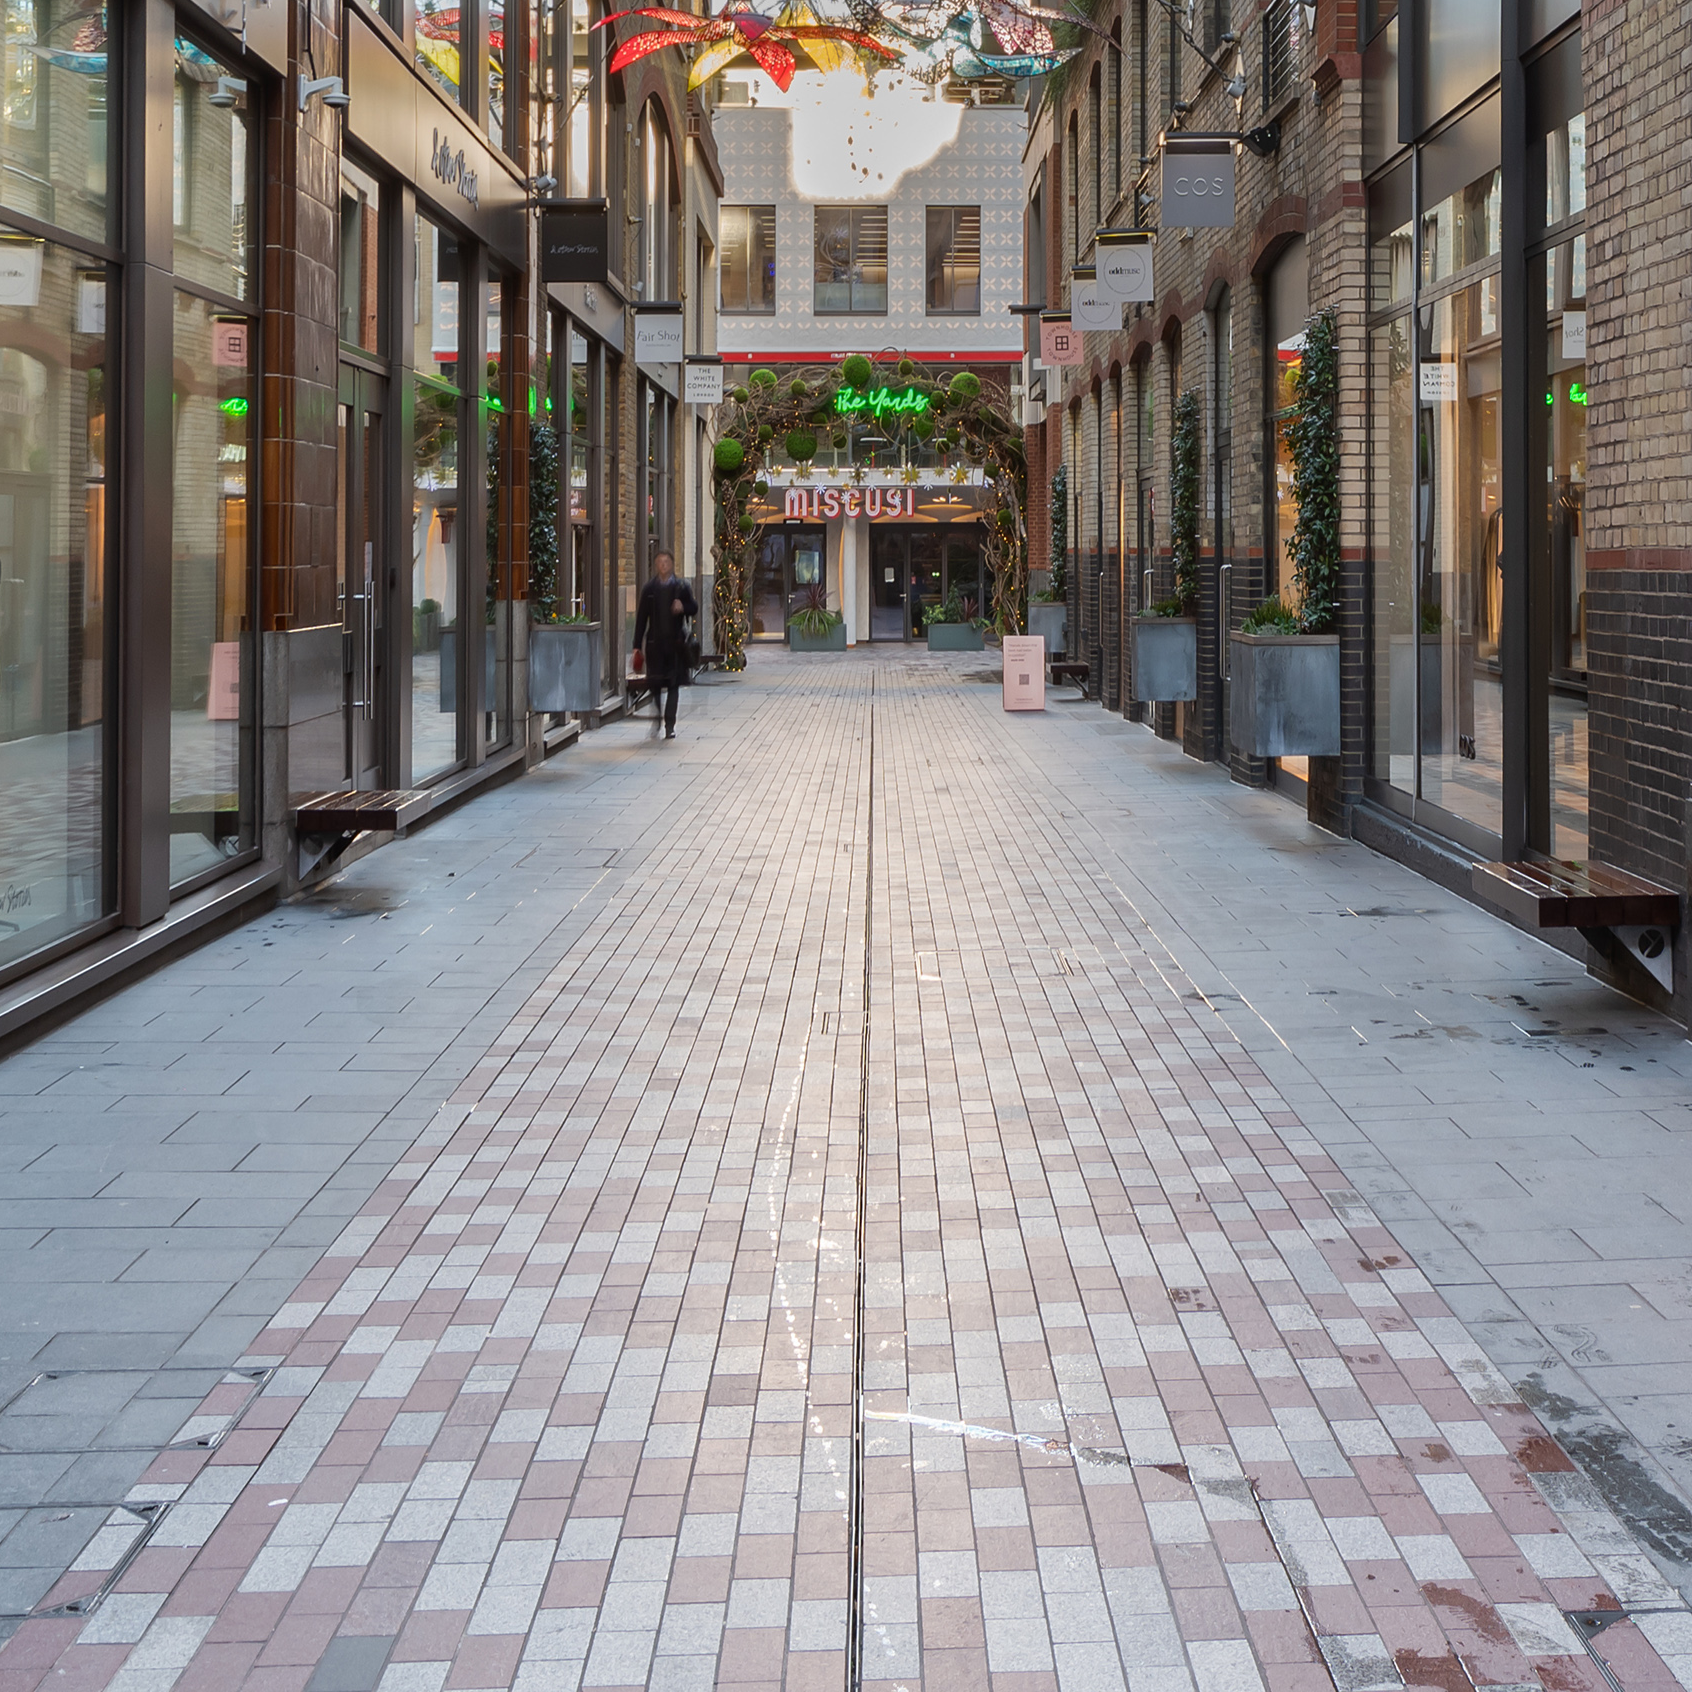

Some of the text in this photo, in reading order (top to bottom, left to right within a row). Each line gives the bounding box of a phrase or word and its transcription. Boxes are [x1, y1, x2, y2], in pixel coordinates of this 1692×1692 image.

[1174, 177, 1224, 197] COS
[637, 330, 680, 342] Fair Shot
[837, 387, 930, 417] The Yards
[785, 488, 914, 519] MISCUSI
